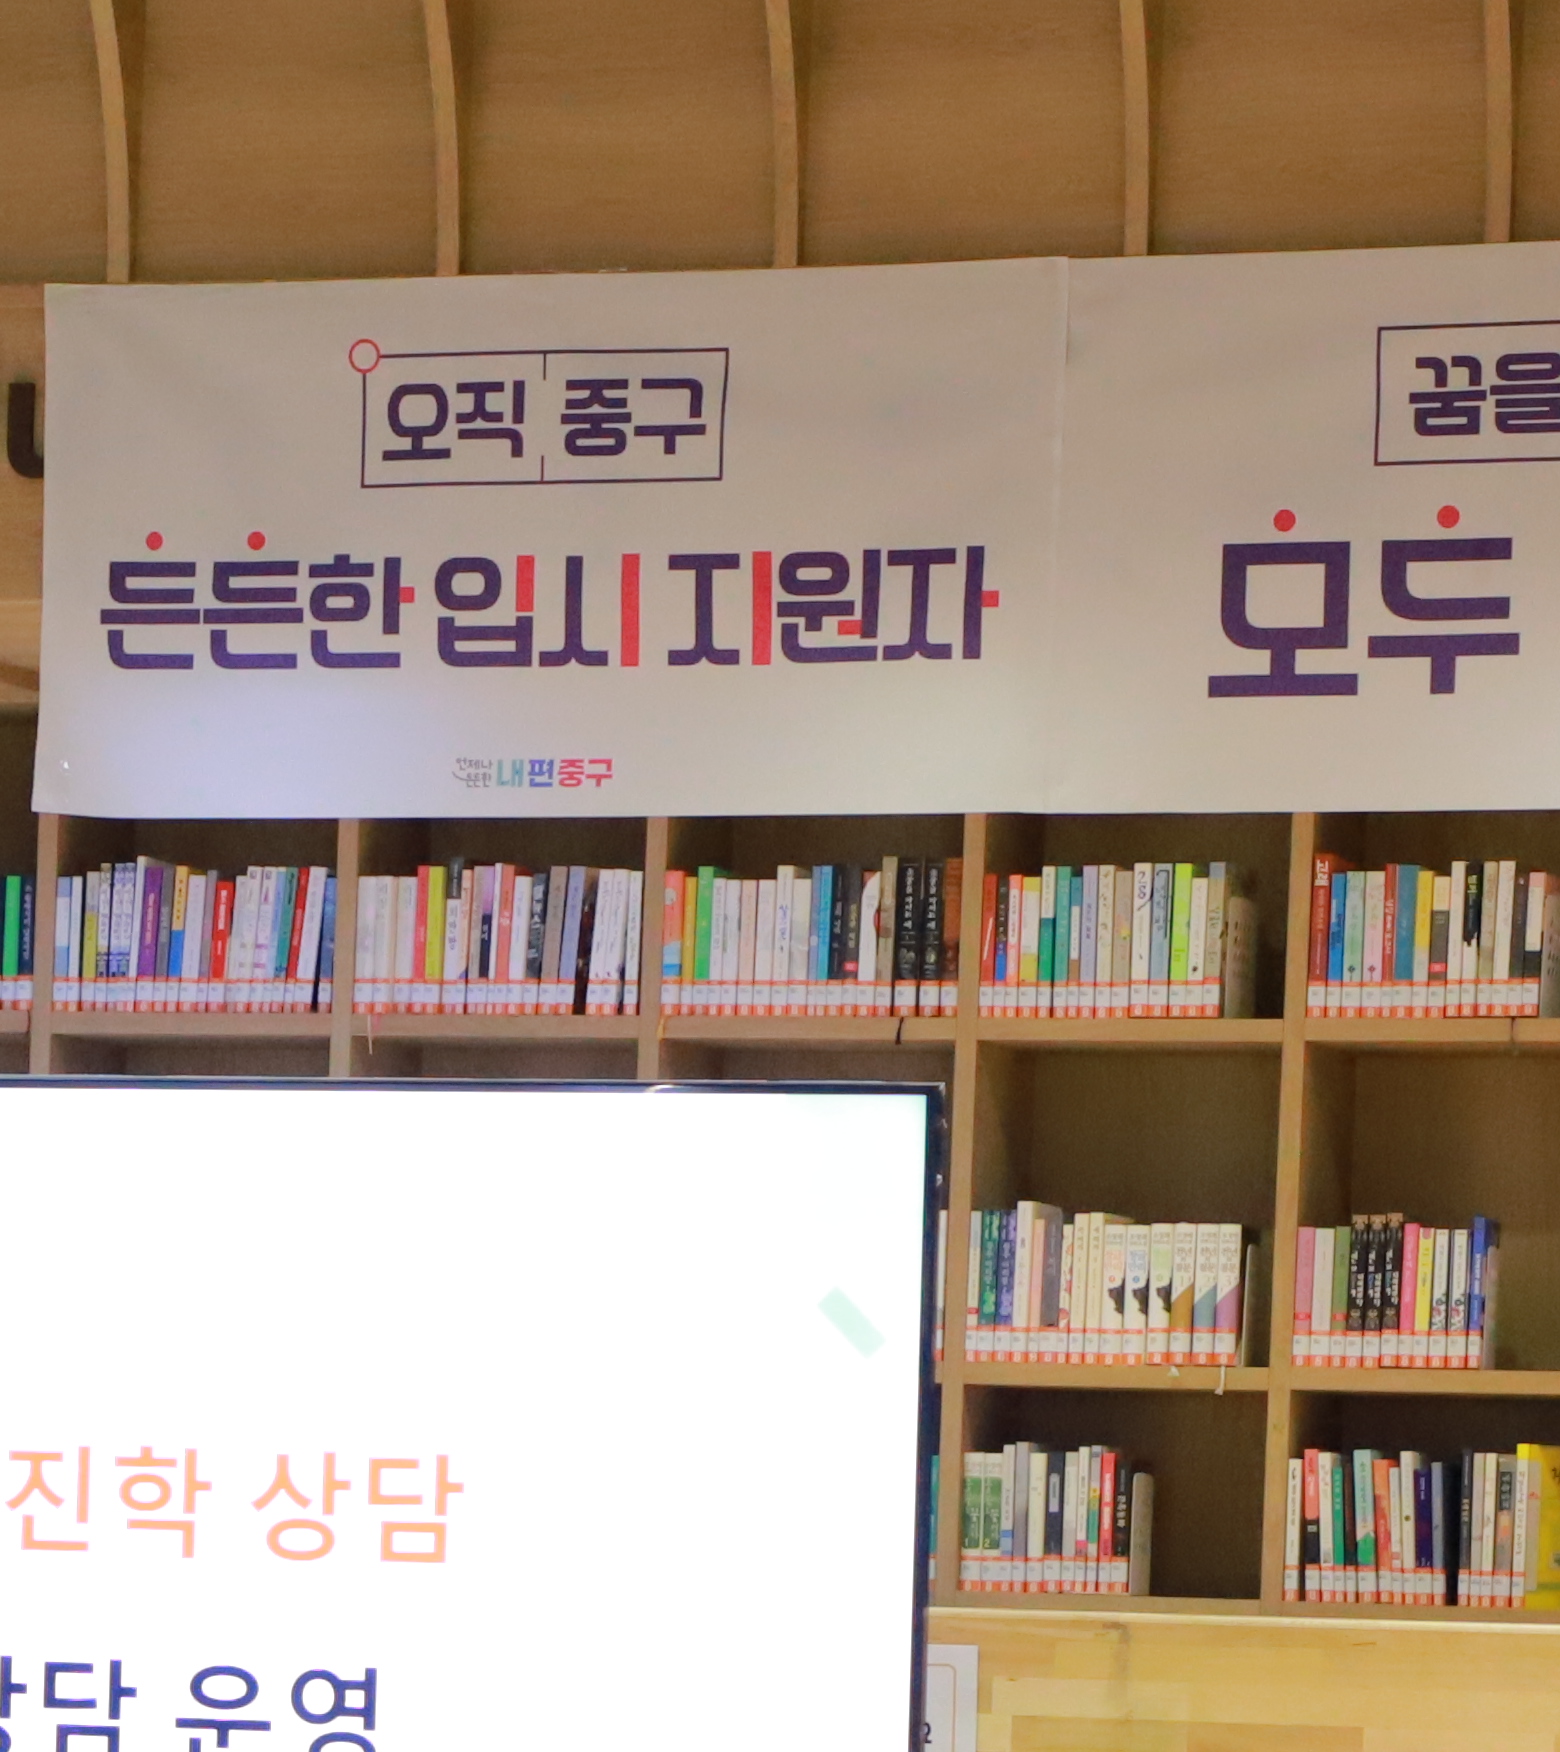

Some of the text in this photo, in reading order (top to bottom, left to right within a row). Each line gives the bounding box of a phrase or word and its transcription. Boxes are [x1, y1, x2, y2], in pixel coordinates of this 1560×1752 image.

[382, 378, 707, 462] 오직 중구
[100, 531, 1001, 671] 든든한 입시 지원자
[1208, 507, 1521, 698] 모두
[6, 1445, 212, 1559] 진학
[251, 1452, 464, 1563] 상담
